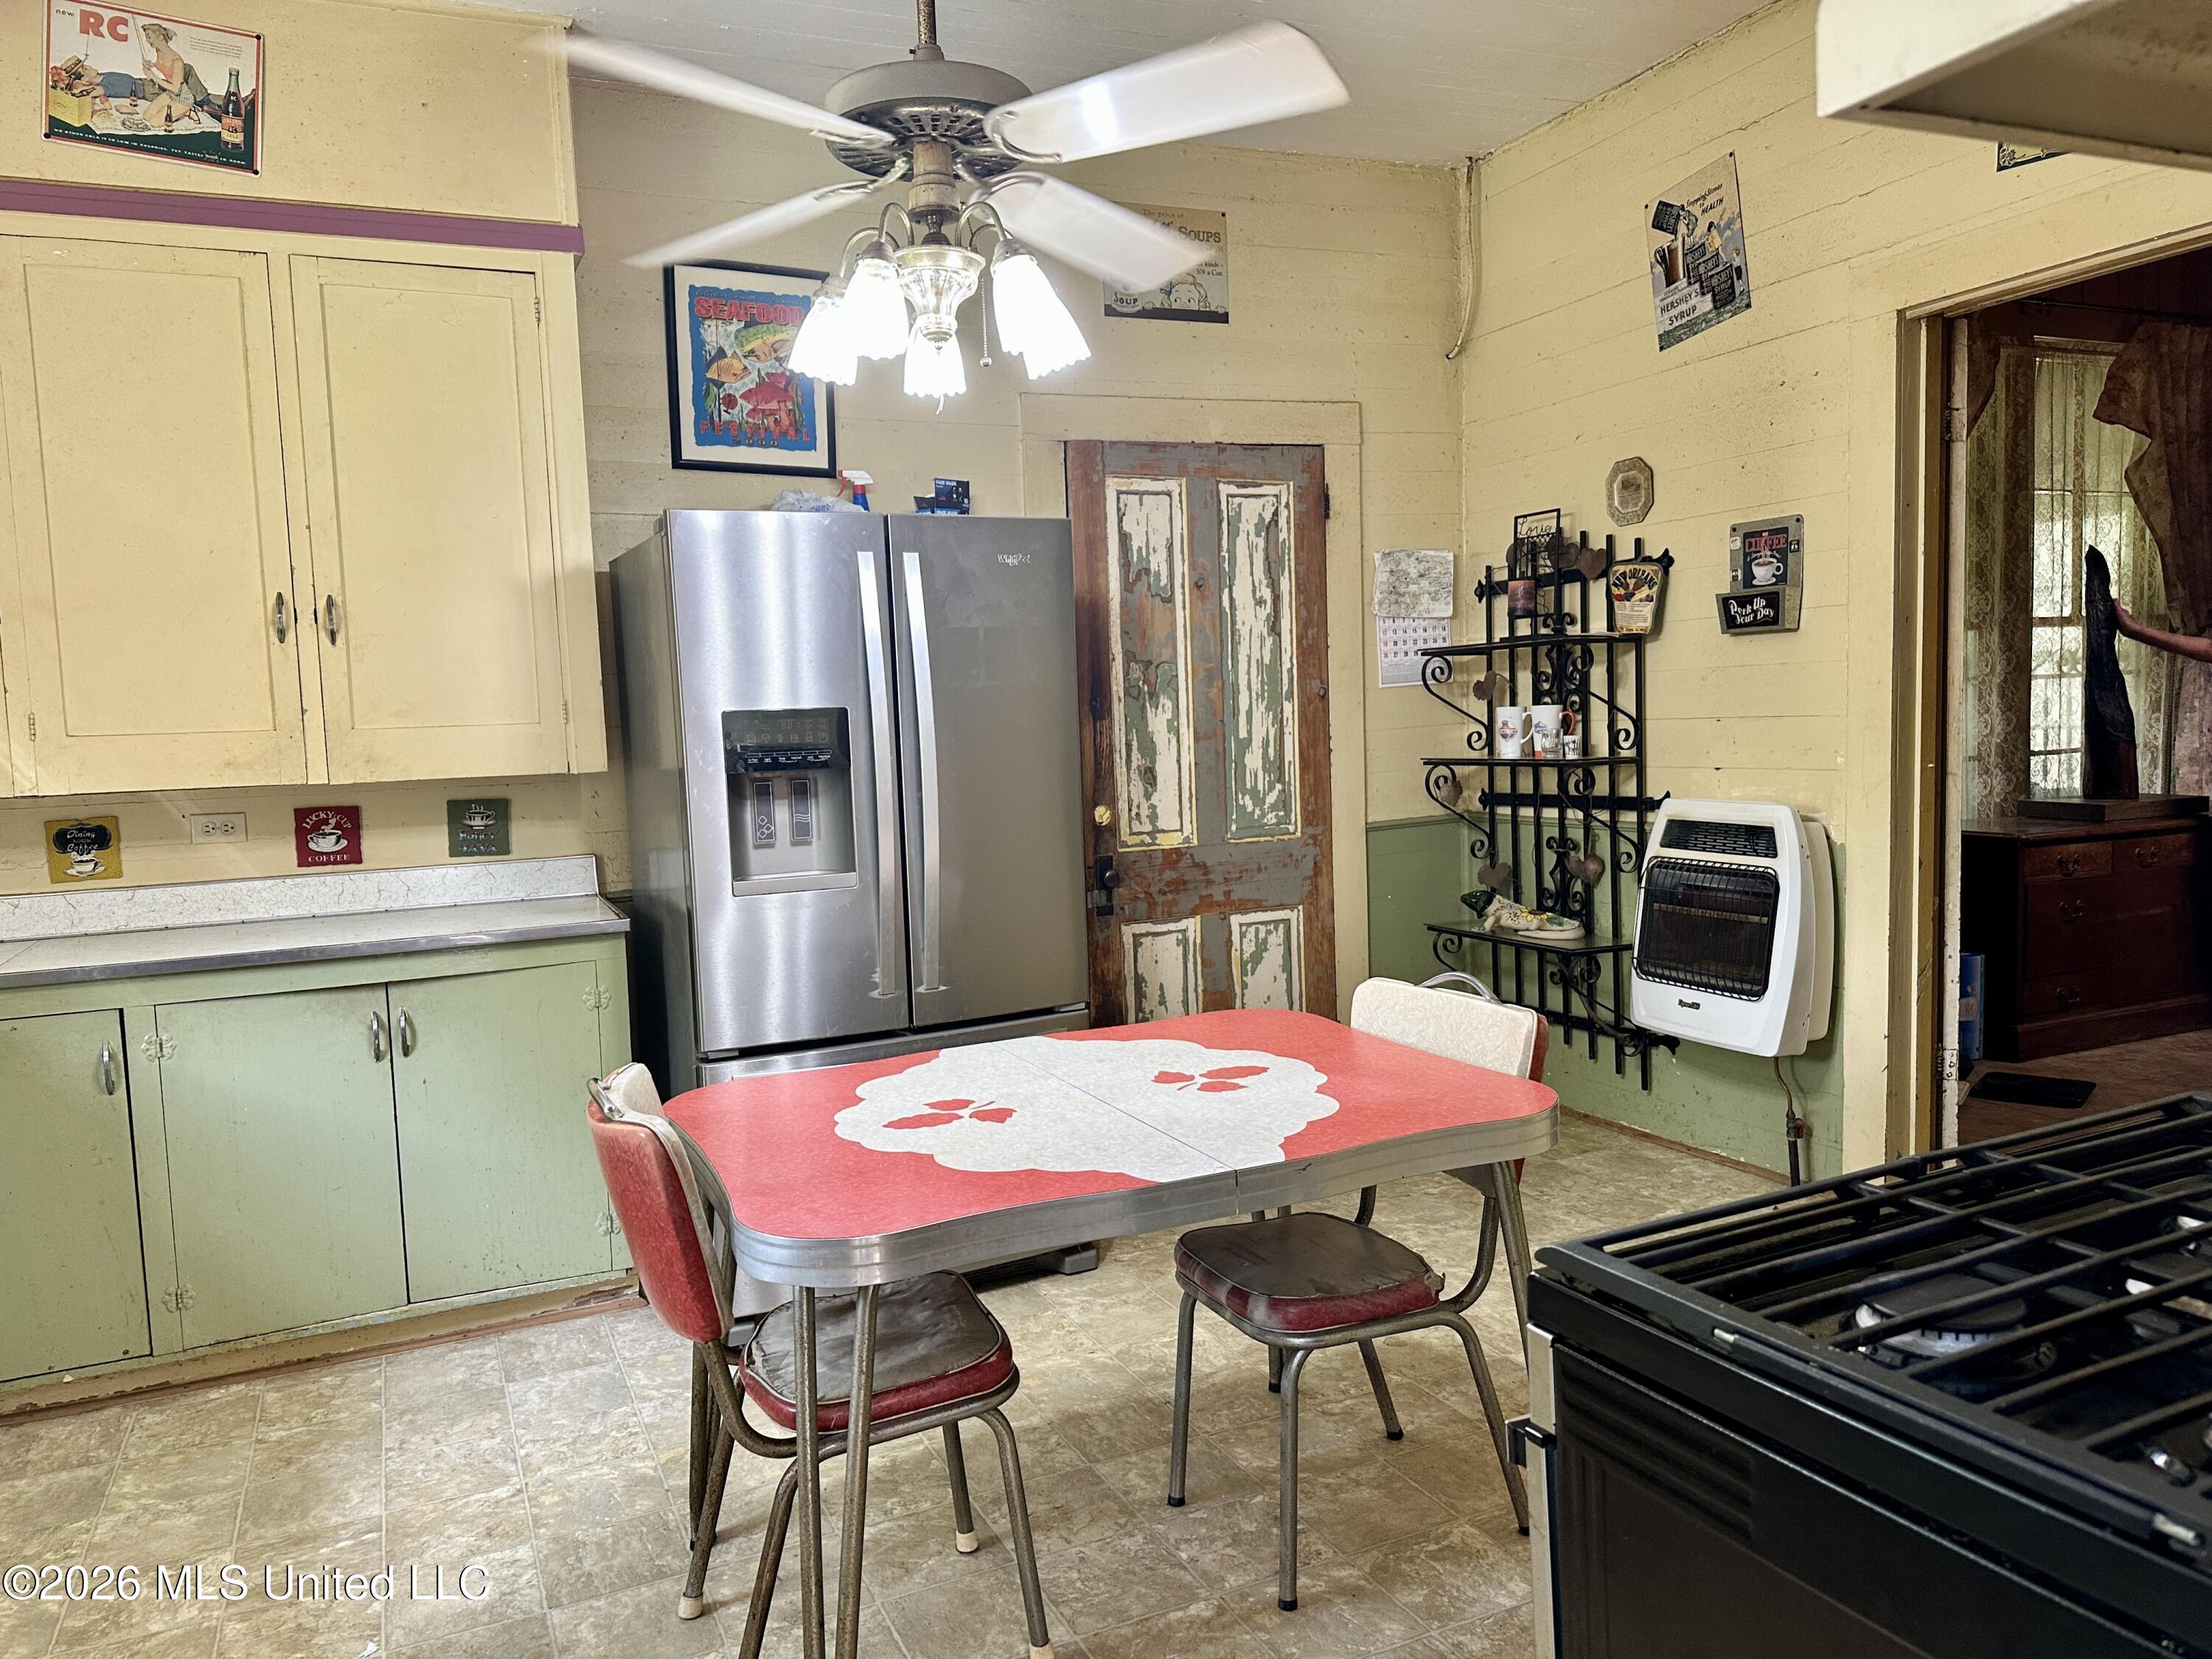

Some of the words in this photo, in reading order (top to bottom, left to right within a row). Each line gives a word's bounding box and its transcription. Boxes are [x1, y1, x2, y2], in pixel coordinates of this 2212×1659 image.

[56, 9, 74, 17] new
[79, 8, 128, 42] RC
[1700, 196, 1724, 216] HEALTH
[1714, 279, 1731, 293] SYRUP
[693, 296, 805, 326] SEAFOOD
[1660, 288, 1700, 316] HERSHEY'S
[1669, 305, 1697, 326] SYRUP
[700, 420, 810, 442] FESTIVAL
[1518, 517, 1552, 538] Love
[1612, 571, 1628, 591] NEW
[1628, 568, 1658, 591] ORLEANS
[1728, 599, 1752, 616] Perk
[1753, 596, 1767, 610] Up
[1735, 613, 1755, 625] Your
[1756, 607, 1775, 620] Day
[302, 811, 335, 830] LUCKY
[336, 814, 352, 829] CUP
[67, 830, 96, 838] Dining
[67, 844, 98, 855] Coffee
[307, 854, 350, 863] COFFEE
